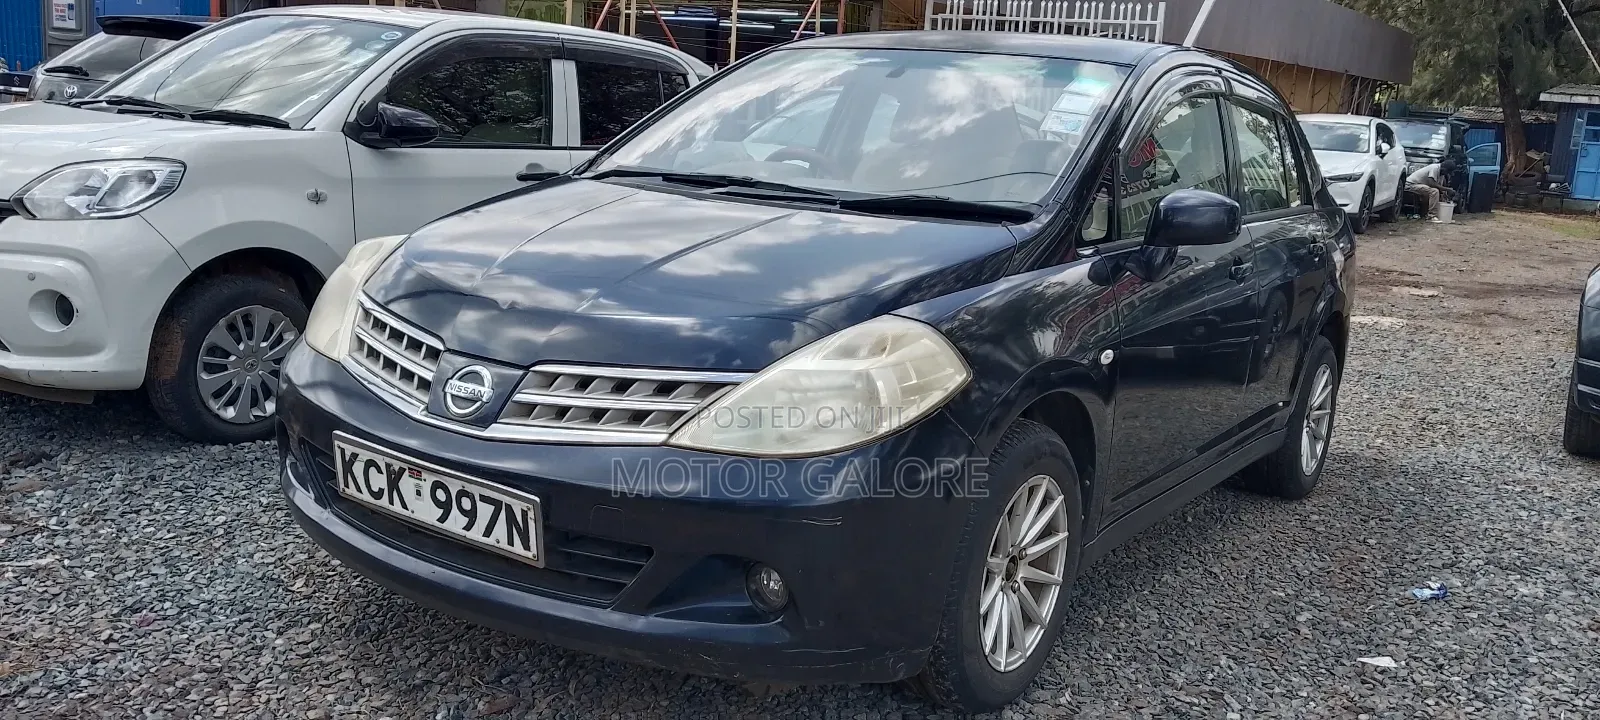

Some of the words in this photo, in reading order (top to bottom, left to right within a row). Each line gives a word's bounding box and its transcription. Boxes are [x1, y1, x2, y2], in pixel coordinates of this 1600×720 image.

[447, 382, 486, 398] NISSAN
[338, 447, 409, 511] KCK
[430, 480, 531, 552] 997N
